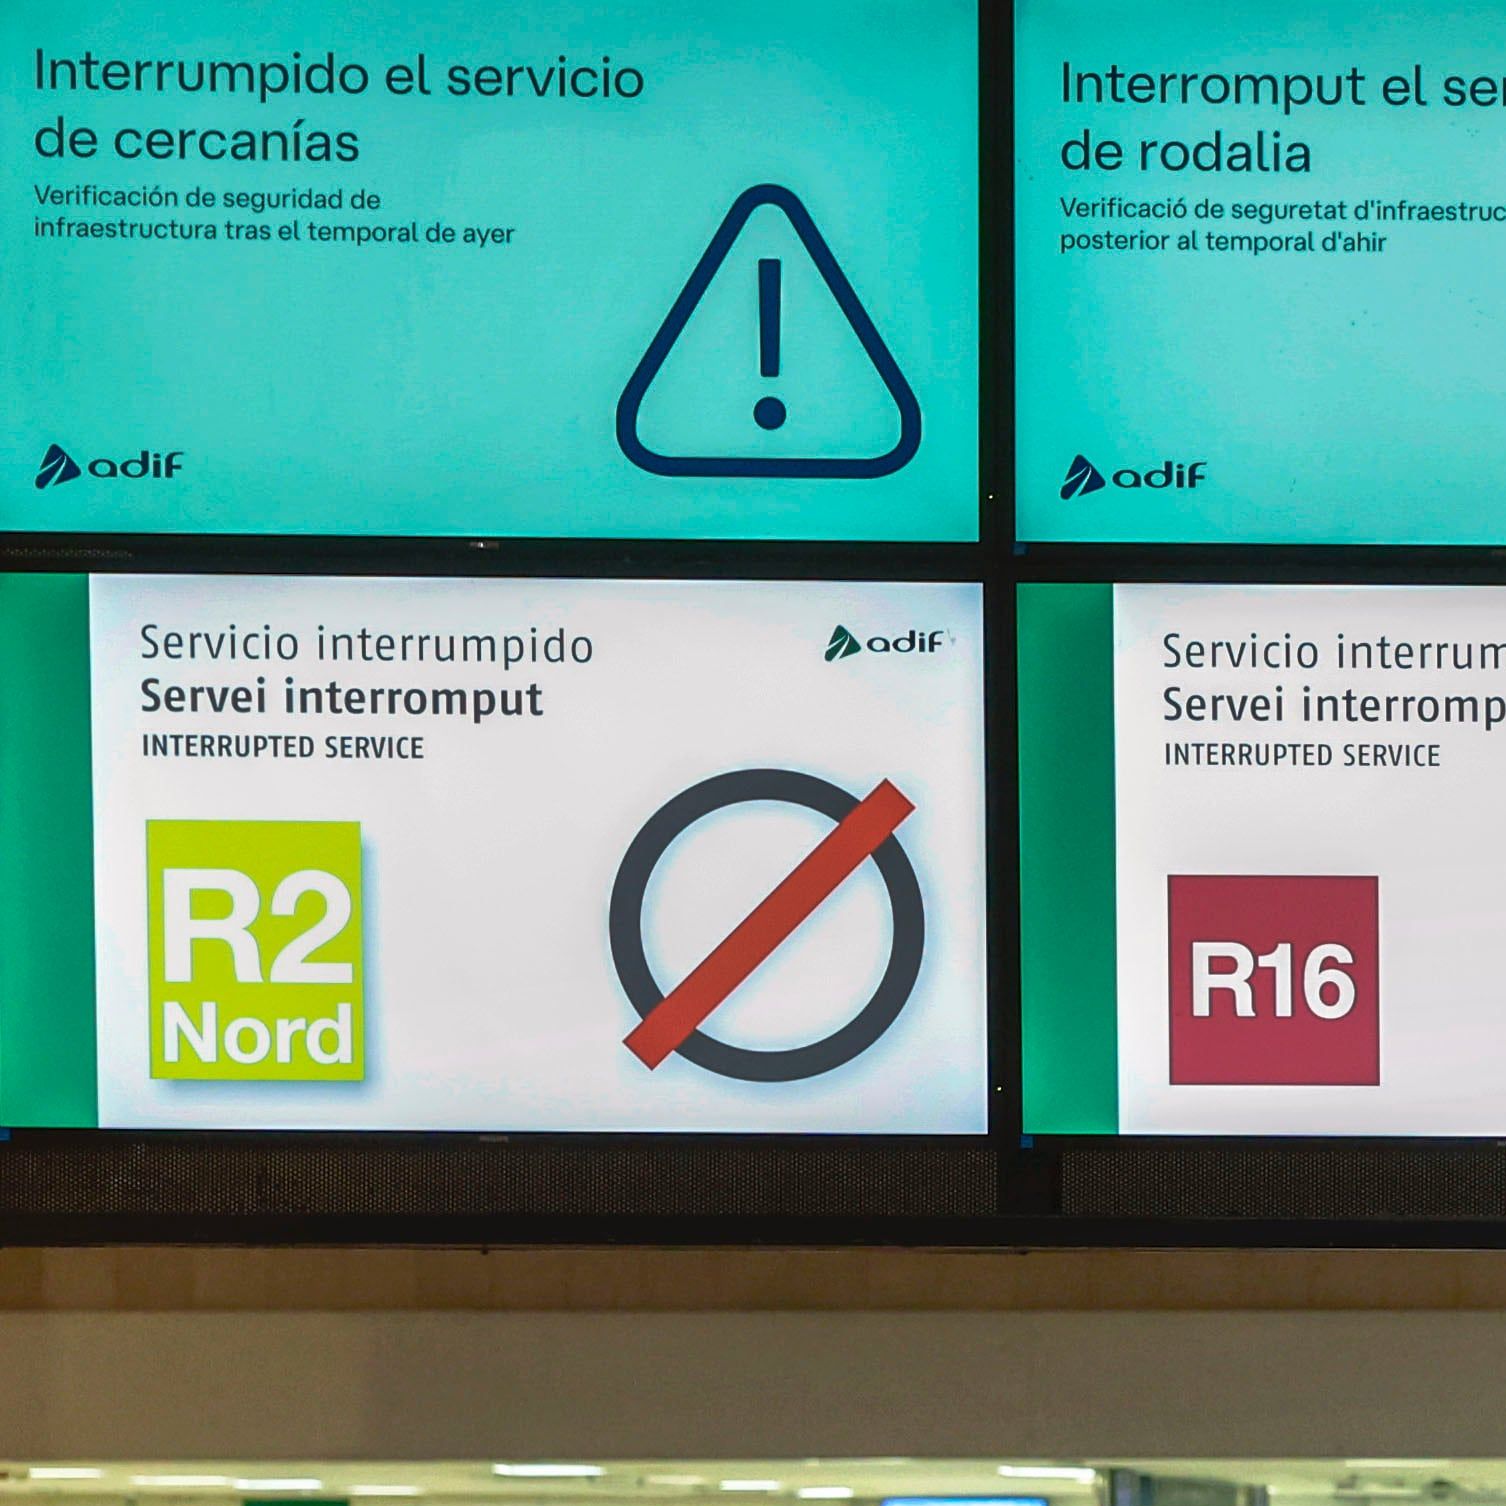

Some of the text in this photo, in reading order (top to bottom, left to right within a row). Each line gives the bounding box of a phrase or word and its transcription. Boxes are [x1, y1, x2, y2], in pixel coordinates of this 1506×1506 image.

[36, 47, 644, 104] Interrumpido el servicio
[1062, 61, 1366, 116] Interromput
[1382, 64, 1428, 106] el
[34, 115, 359, 162] de cercanías
[1061, 128, 1311, 173] de rodalia
[33, 184, 381, 214] Verificación de seguridad de
[1059, 196, 1188, 219] Verificació
[1193, 197, 1225, 220] de
[1231, 200, 1348, 225] seguretat
[34, 215, 516, 249] infraestructura tras el temporal de ayer
[1060, 229, 1388, 256] posterior al temporal d'ahir
[87, 450, 184, 479] adif
[1112, 460, 1207, 489] adif
[140, 623, 593, 671] Servicio interrumpido
[866, 629, 944, 653] adif
[1163, 632, 1318, 669] Servicio
[141, 675, 544, 725] Servei interromput
[1163, 685, 1283, 722] Servei
[142, 733, 424, 760] INTERRUPTED SERVICE
[1165, 742, 1440, 767] INTERRUPTED SERVICE
[162, 867, 354, 985] R2
[1192, 941, 1356, 1020] R16
[162, 1000, 354, 1065] Nord
